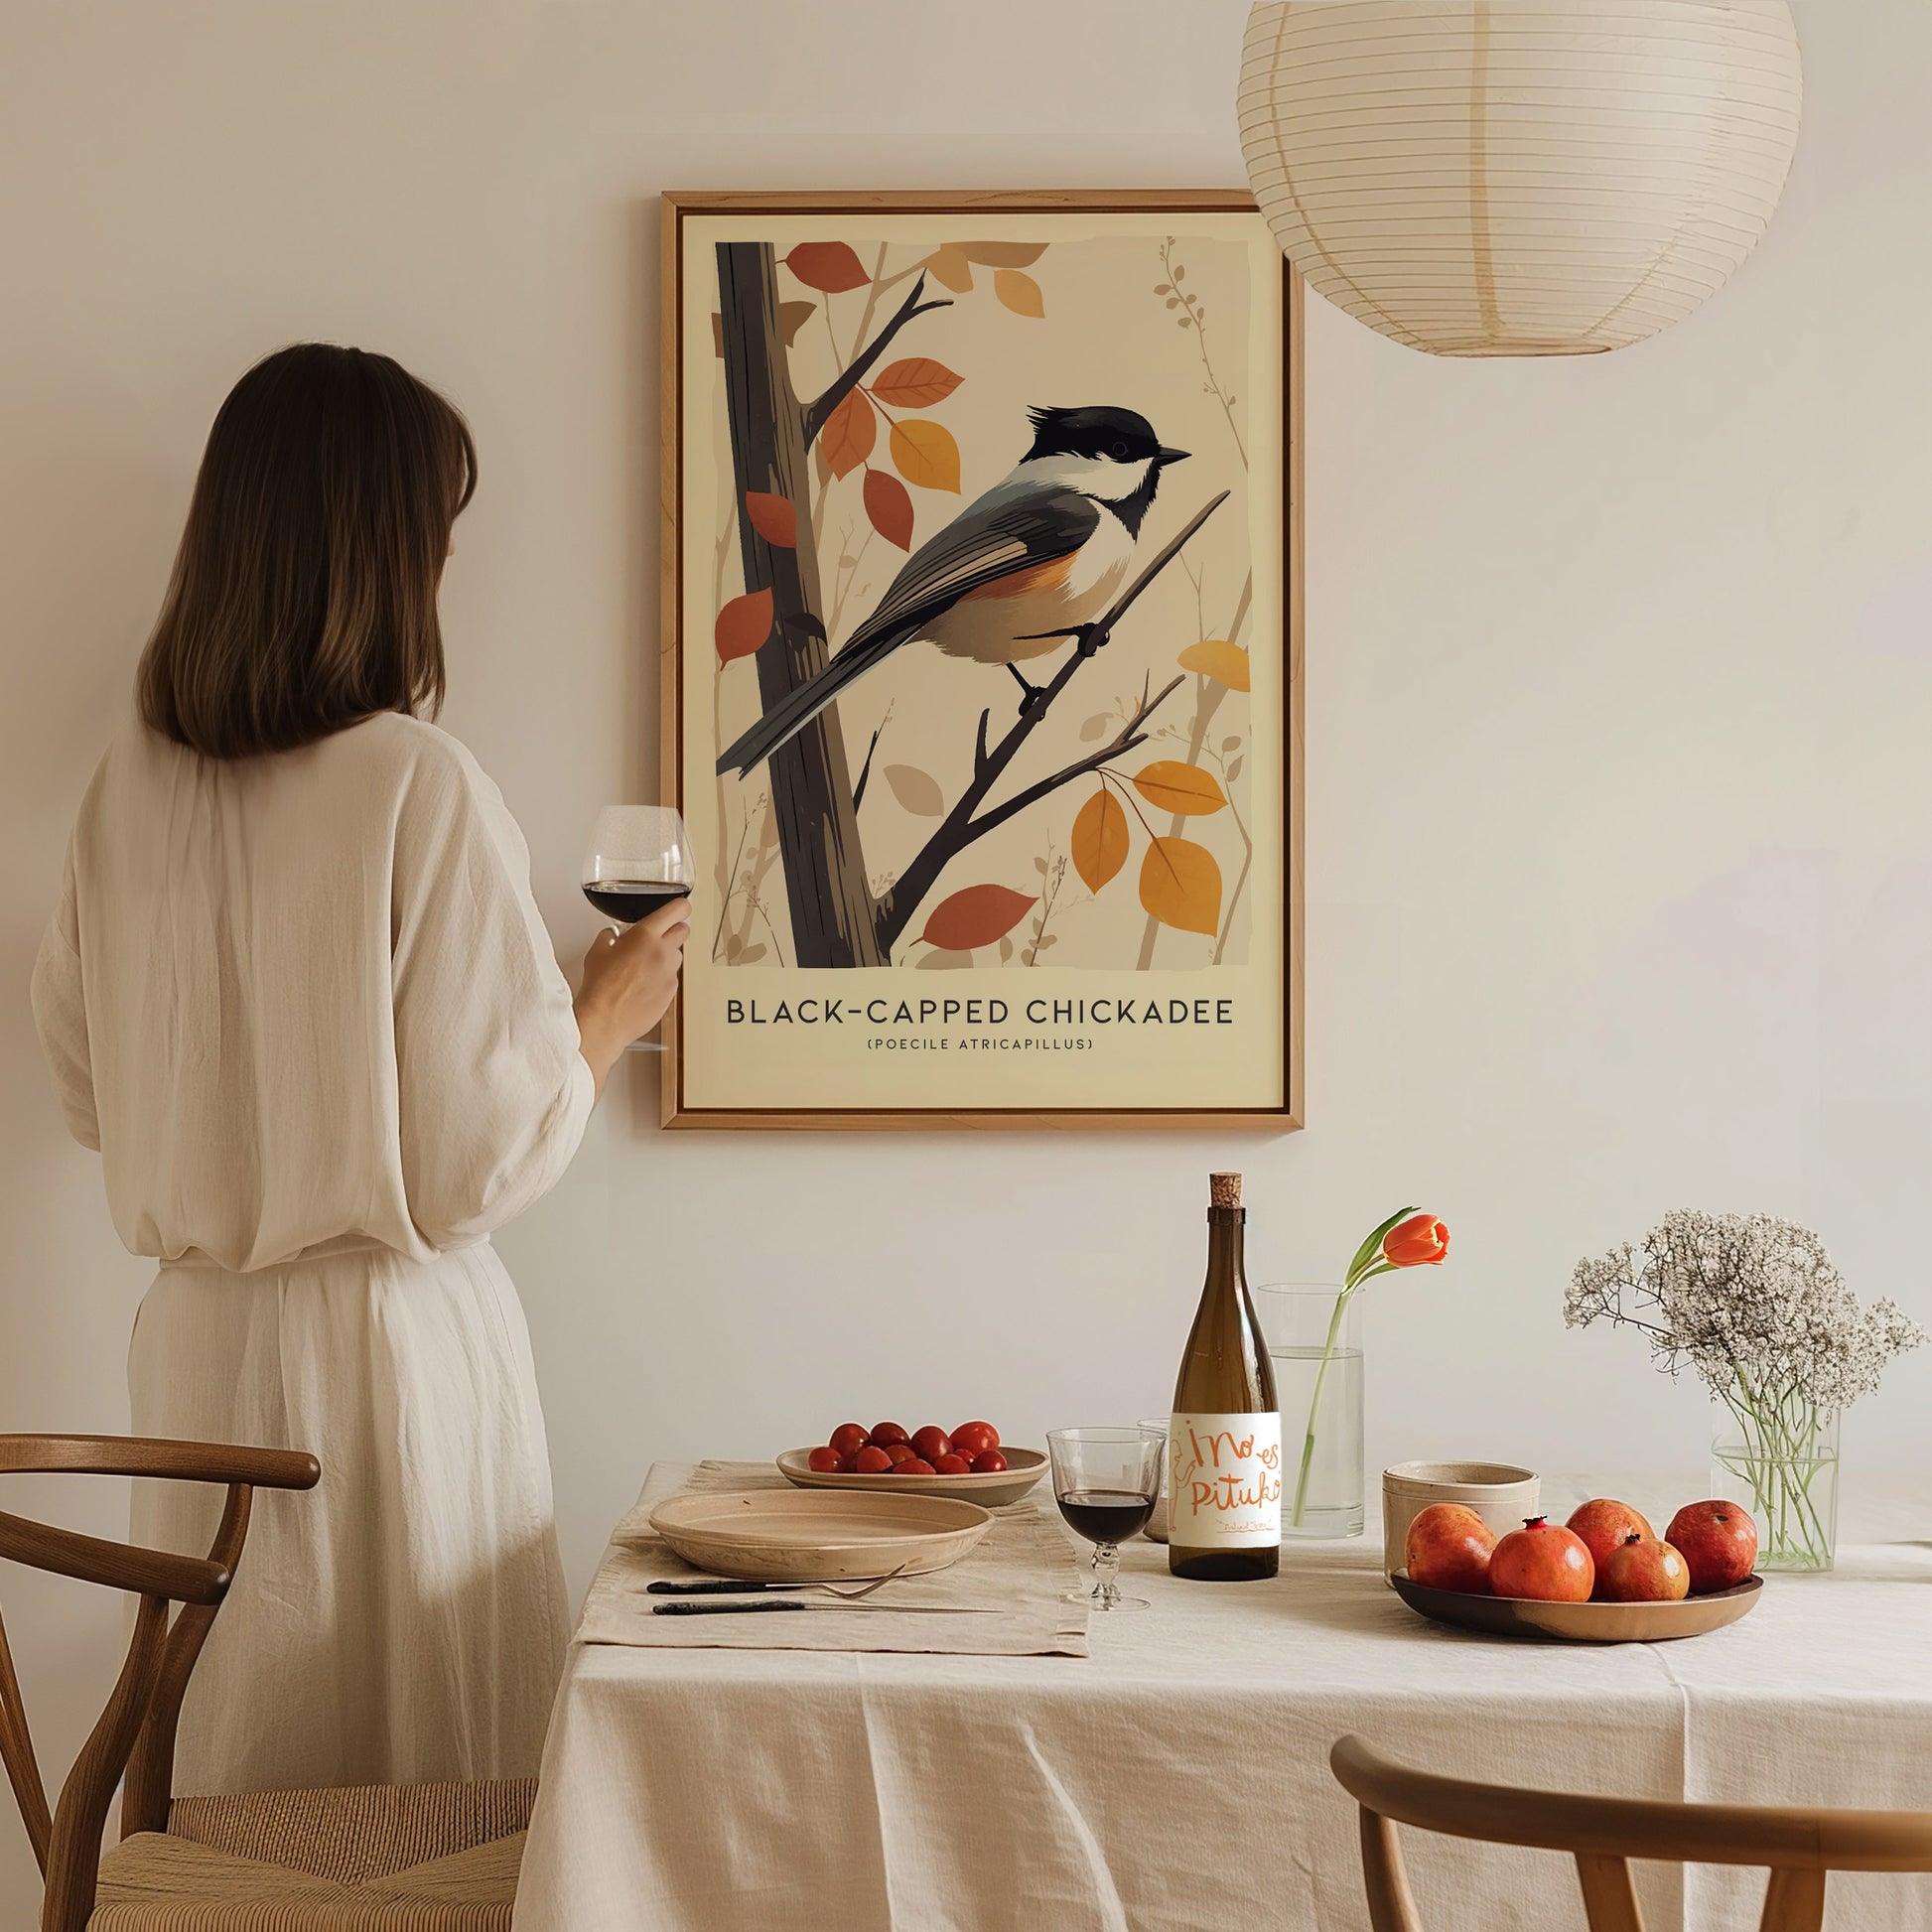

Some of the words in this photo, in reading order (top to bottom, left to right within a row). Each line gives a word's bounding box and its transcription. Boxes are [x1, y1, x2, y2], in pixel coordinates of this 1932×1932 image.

[727, 999, 1009, 1024] BLACK-CAPPED
[1026, 999, 1233, 1024] CHICKADEE
[867, 1038, 949, 1050] (POECILE
[958, 1038, 1092, 1050] ATRICAPILLUS)
[1256, 1444, 1279, 1469] es
